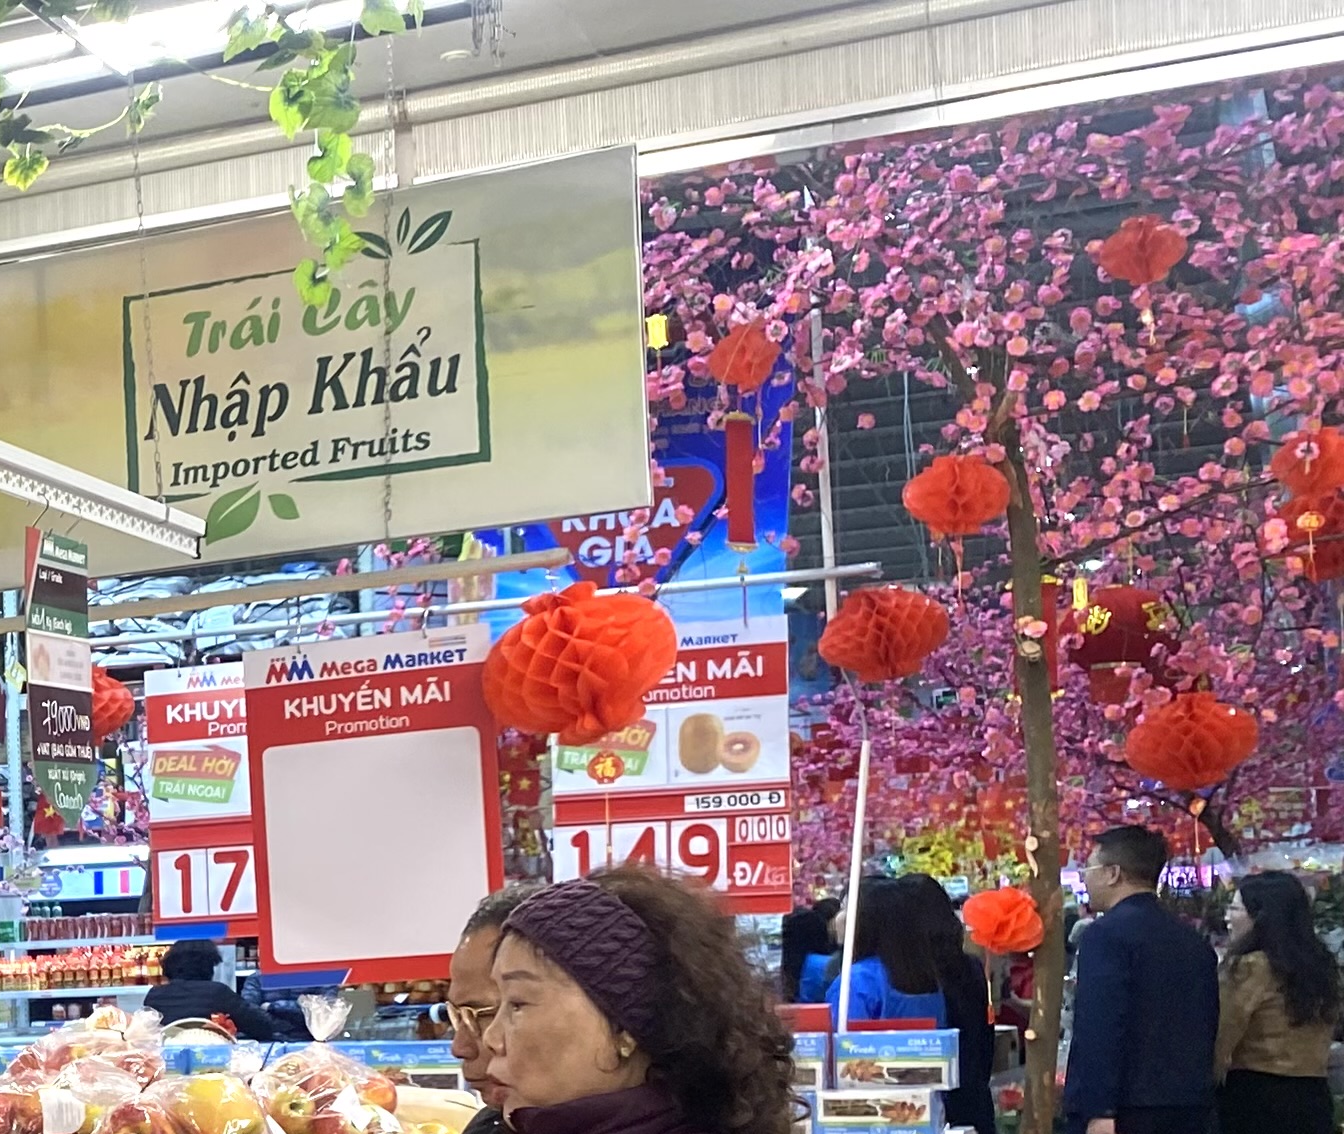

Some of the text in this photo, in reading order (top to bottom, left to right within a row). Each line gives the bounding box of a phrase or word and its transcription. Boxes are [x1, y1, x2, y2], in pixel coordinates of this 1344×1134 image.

[182, 296, 281, 358] Trái
[144, 326, 462, 443] Nhập Khẩu
[169, 427, 432, 489] Imported Fruits
[707, 650, 764, 680] MÃI
[284, 676, 452, 721] KHUYẾN MÃI
[642, 685, 715, 703] omotion
[325, 715, 410, 736] Promotion
[154, 755, 198, 775] DEAL
[159, 780, 185, 795] TRÁI
[768, 791, 782, 805] Đ
[739, 816, 787, 842] 000
